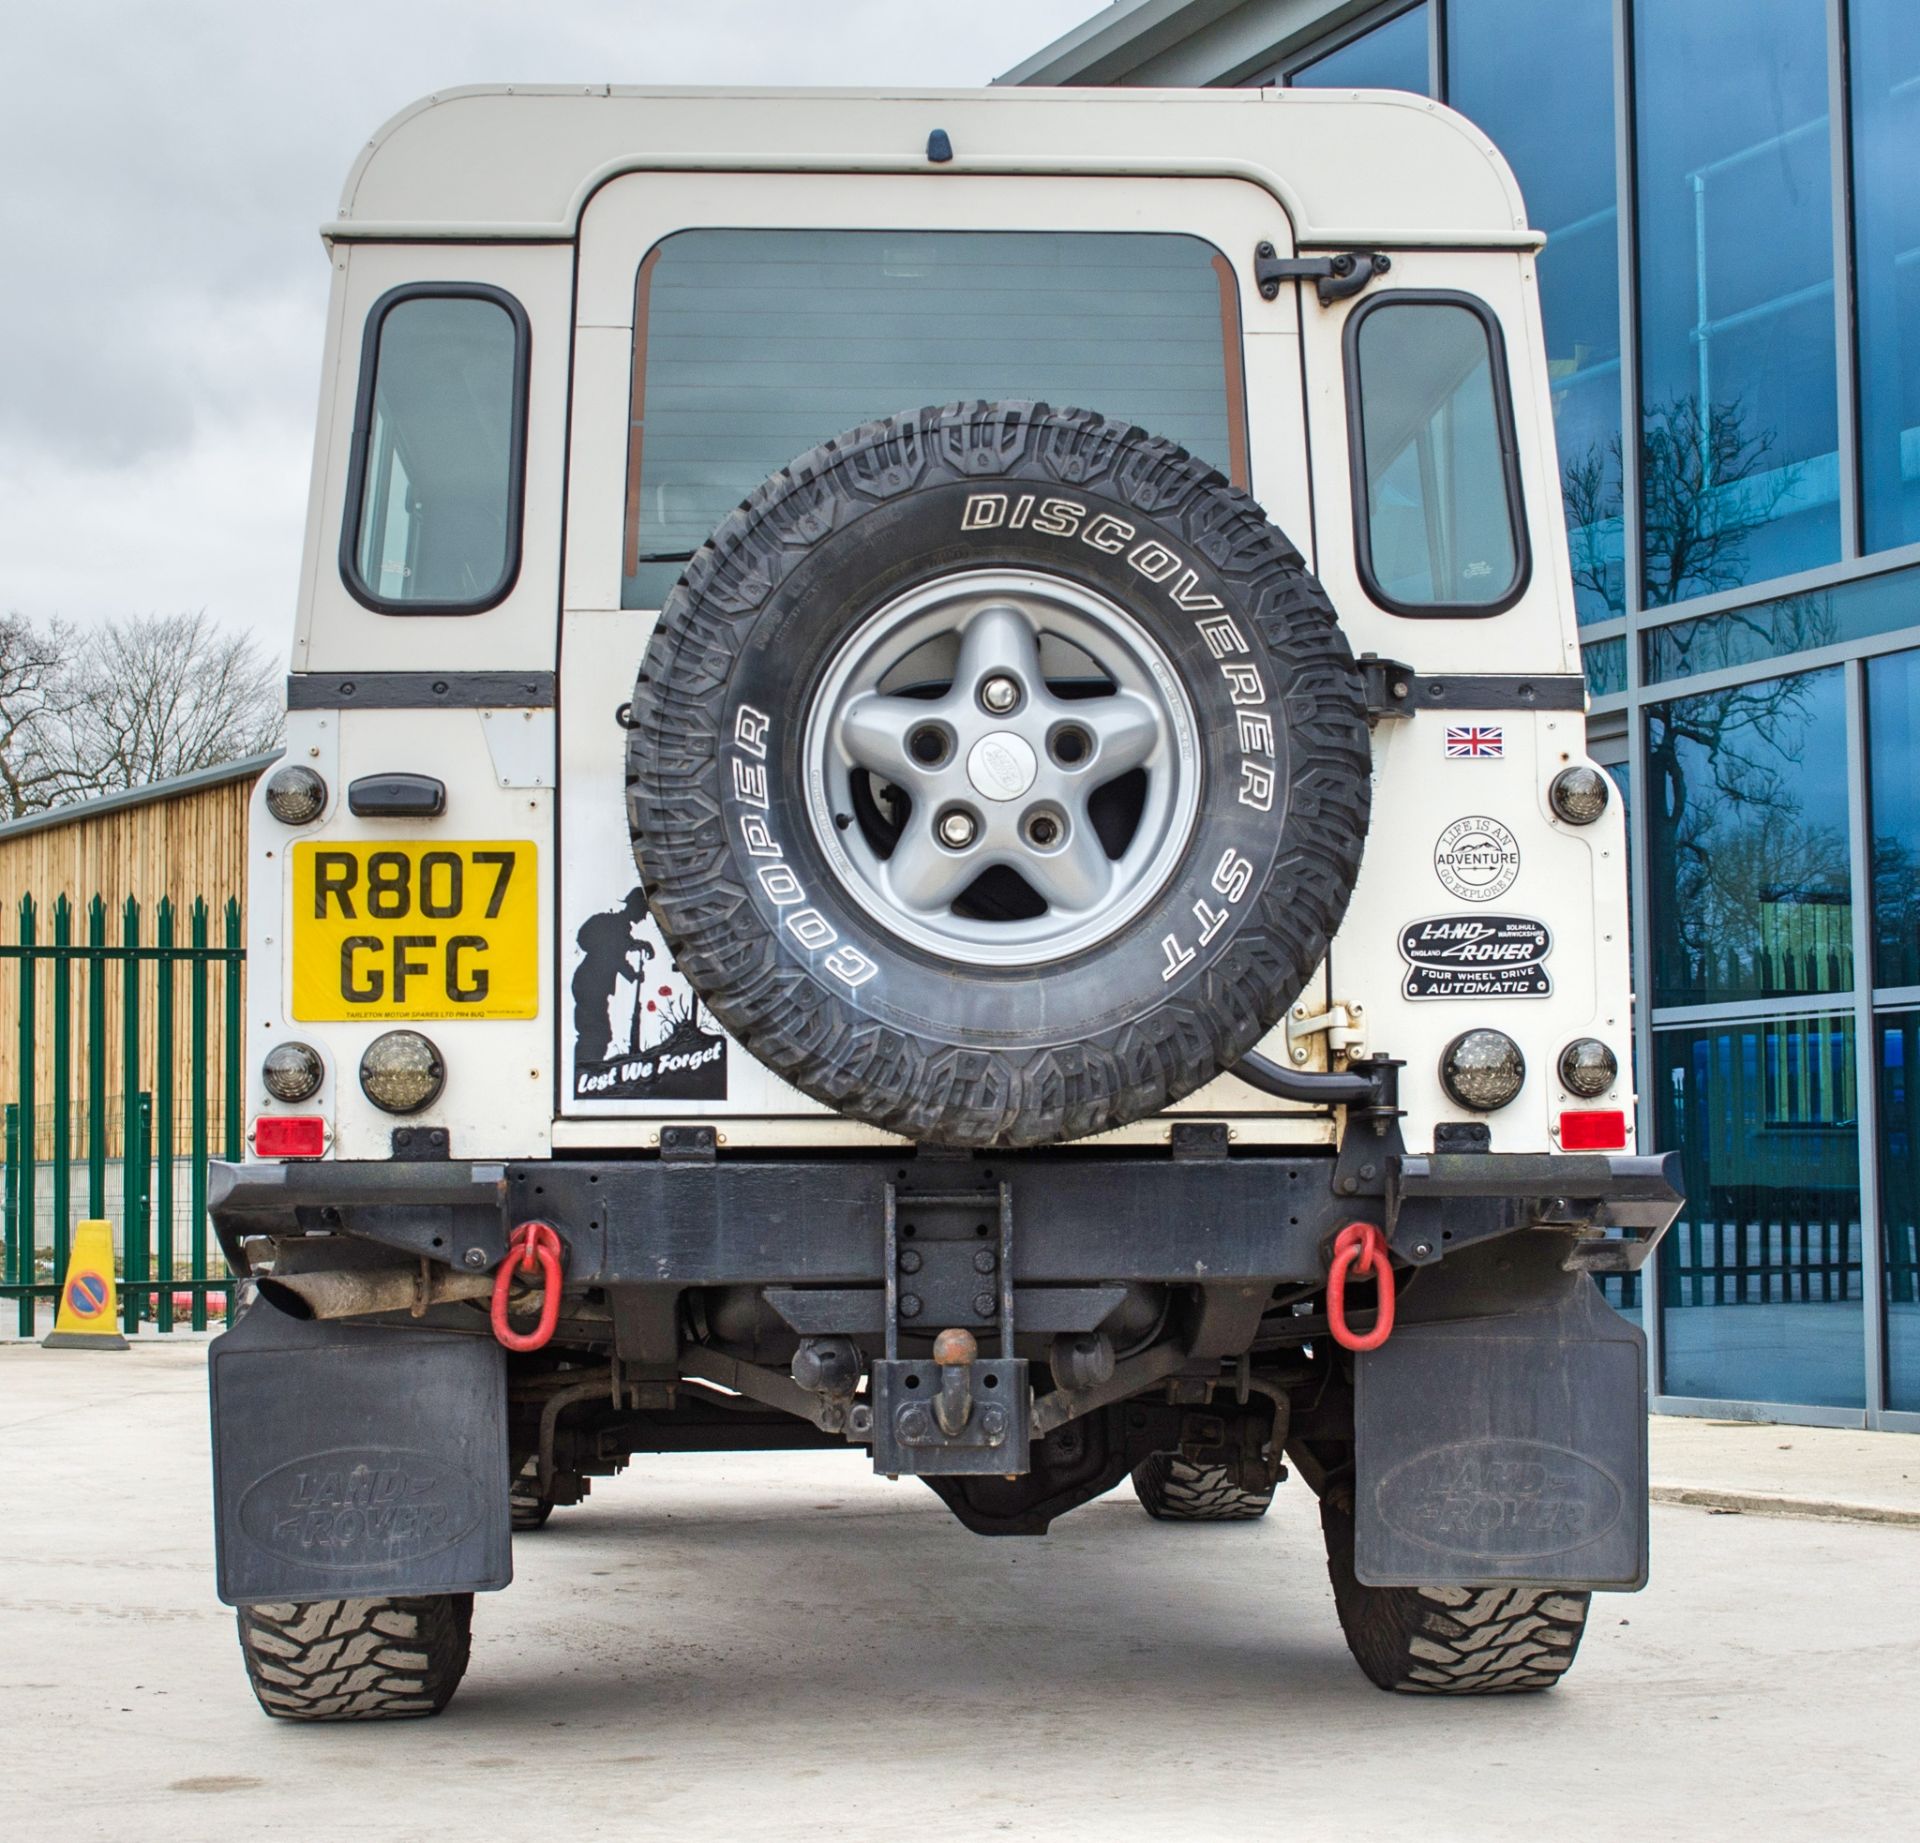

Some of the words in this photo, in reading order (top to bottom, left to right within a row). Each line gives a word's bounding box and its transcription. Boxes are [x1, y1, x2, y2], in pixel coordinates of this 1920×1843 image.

[961, 494, 1276, 812] DISCOVERER
[1160, 847, 1253, 983] STT
[1442, 820, 1473, 846] LIFE
[1475, 819, 1490, 832] IS
[1491, 827, 1513, 846] AN
[734, 704, 879, 987] COOPER
[1437, 852, 1518, 865] ADVENTURE
[314, 851, 516, 919] R807
[1452, 879, 1507, 899] EXPLORE
[1420, 923, 1483, 940] LAND
[1410, 949, 1442, 957] ENGLAND
[1459, 943, 1534, 961] ROVER
[340, 935, 490, 1003] GFG
[1422, 969, 1452, 980] FOUR
[1457, 972, 1497, 981] WHEEL
[1501, 967, 1535, 980] DRIVE
[1426, 981, 1530, 994] AUTOMATIC
[577, 1067, 617, 1093] Lest
[621, 1060, 653, 1083] We
[657, 1041, 722, 1075] Forget
